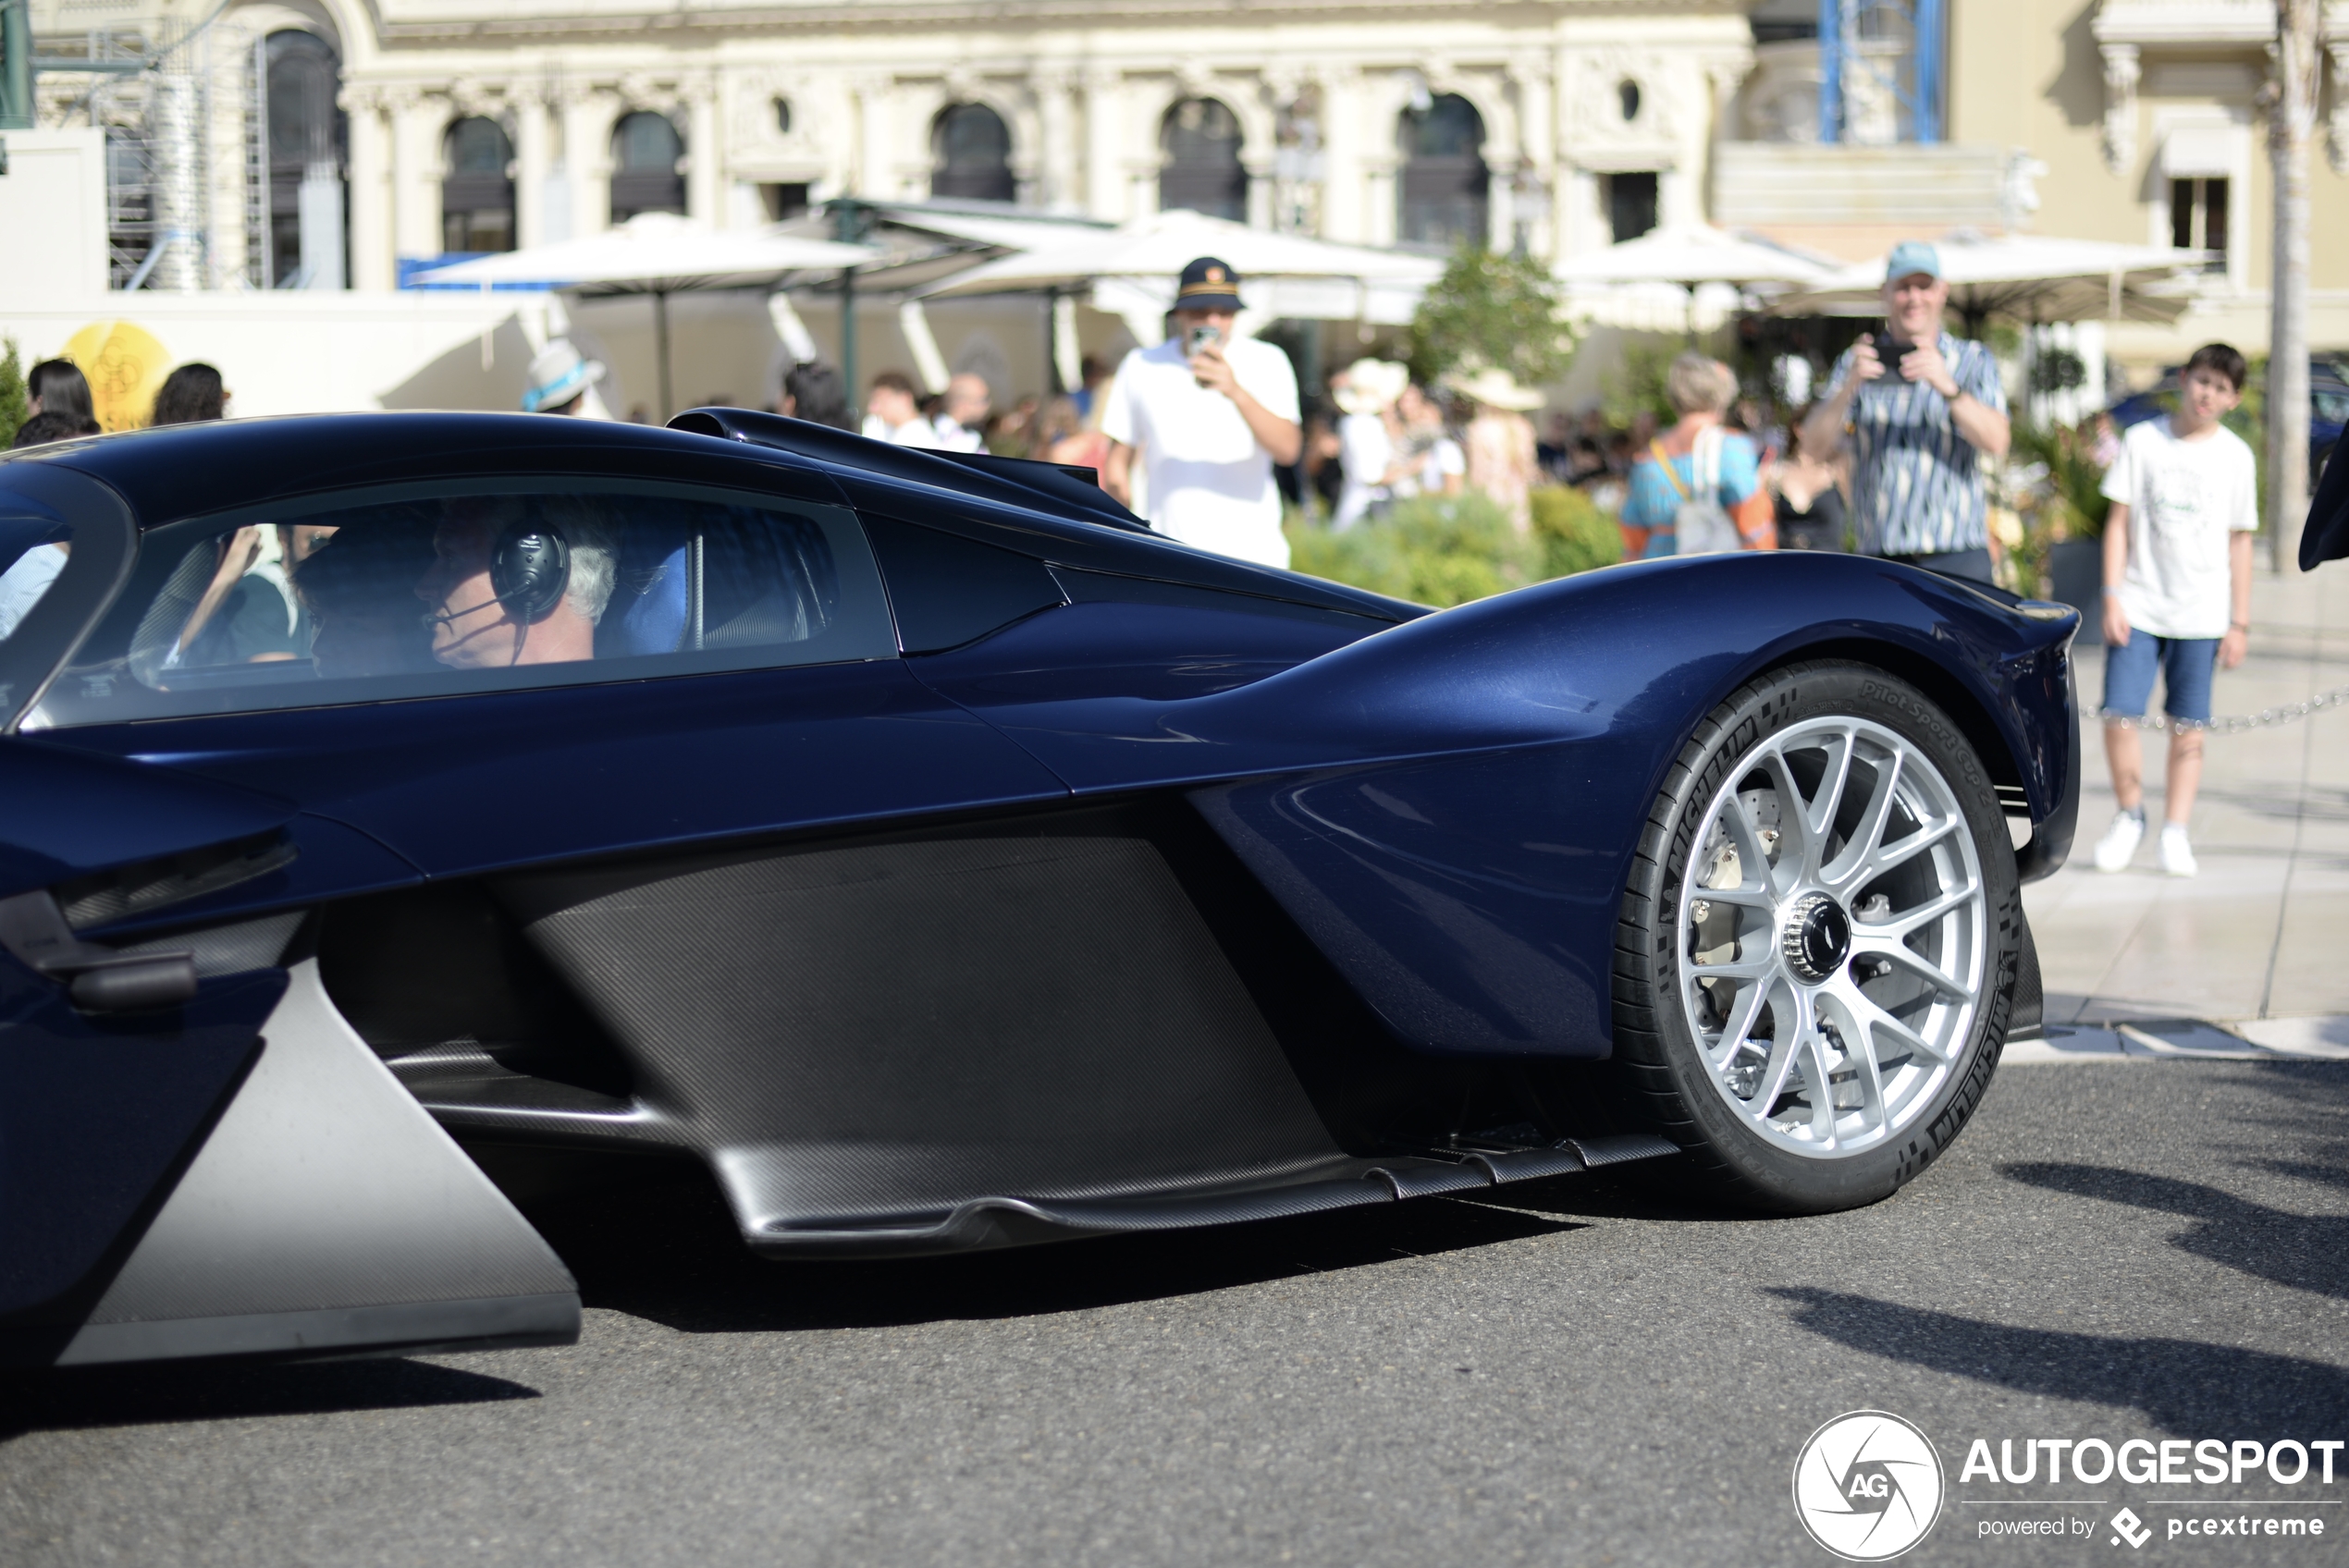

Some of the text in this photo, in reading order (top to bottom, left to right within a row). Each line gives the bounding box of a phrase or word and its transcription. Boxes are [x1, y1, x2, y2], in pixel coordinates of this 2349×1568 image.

[1667, 717, 1757, 876] MICHELIN
[1860, 680, 1909, 709] Pilot
[1908, 700, 1958, 750] Sport
[1954, 747, 1983, 787] Cup
[1978, 788, 1995, 807] 2
[1932, 993, 2011, 1148] MICHELIN
